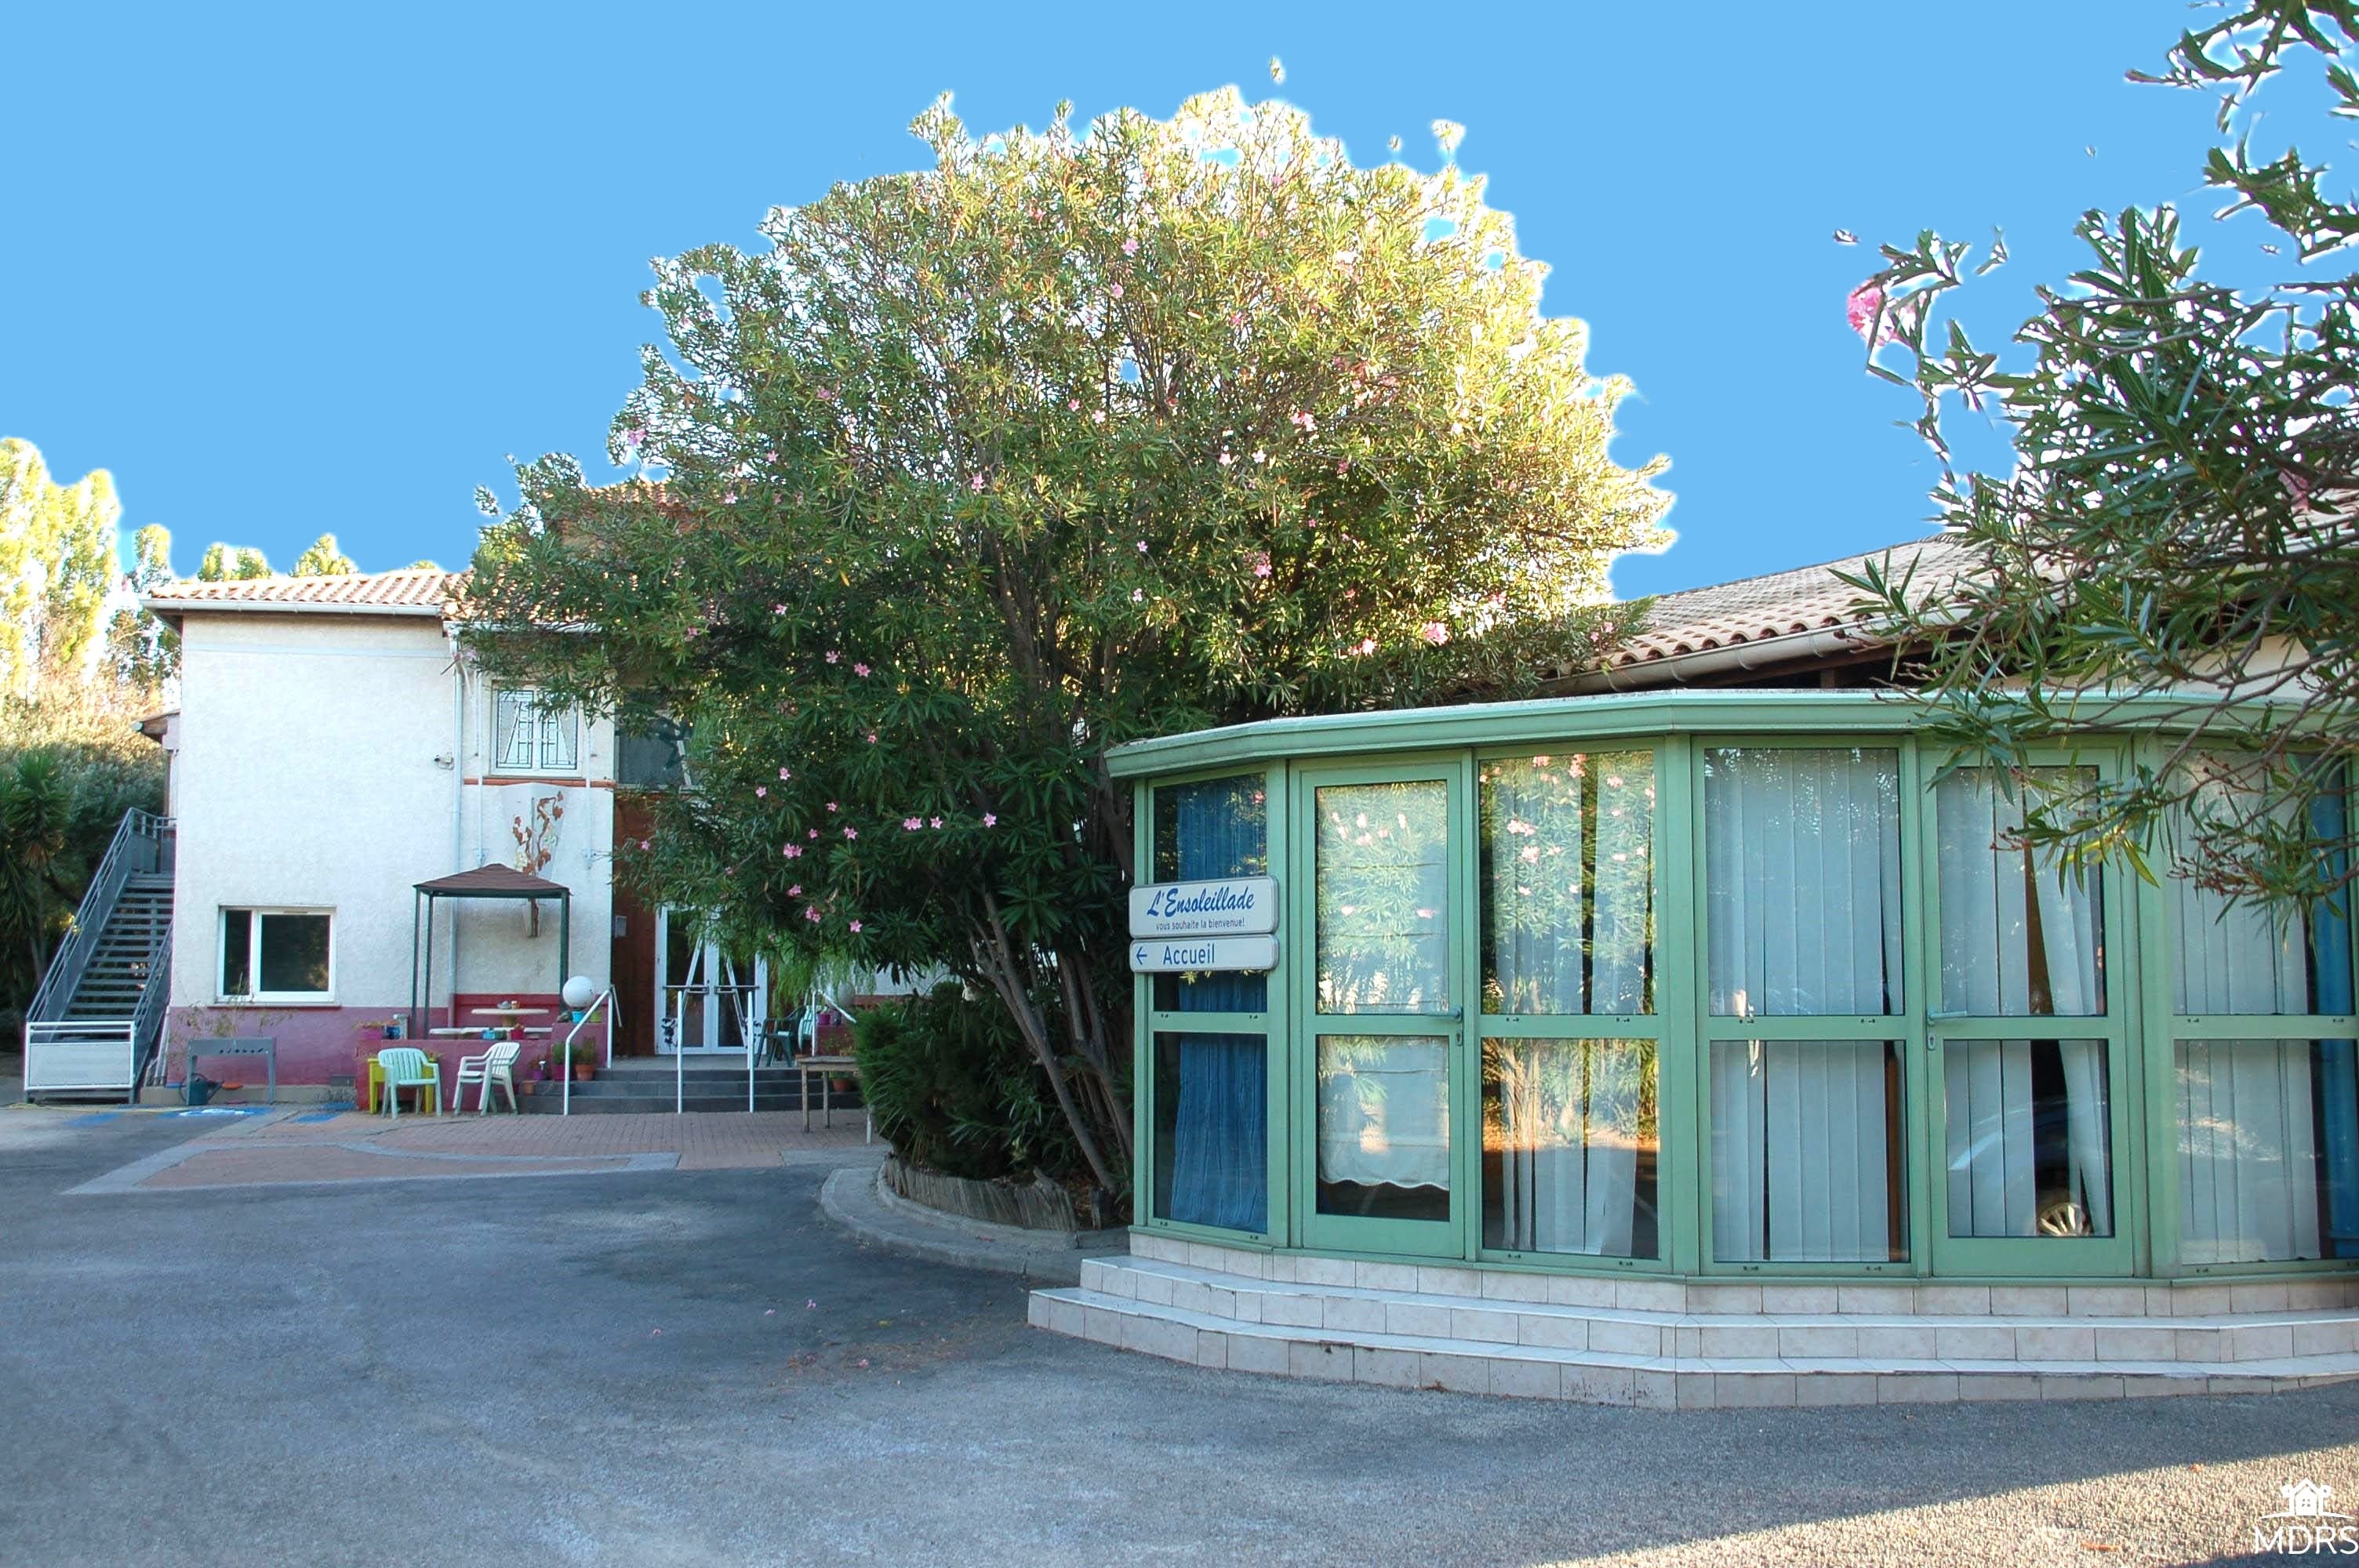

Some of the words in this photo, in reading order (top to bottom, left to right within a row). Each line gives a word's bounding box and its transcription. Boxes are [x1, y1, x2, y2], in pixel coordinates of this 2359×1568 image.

[1147, 886, 1255, 917] L'Ensoleillade
[1156, 922, 1170, 931] vous
[1172, 919, 1199, 930] souhaite
[1201, 919, 1207, 928] la
[1209, 919, 1245, 928] bienvenue!
[1163, 943, 1215, 965] Accueil
